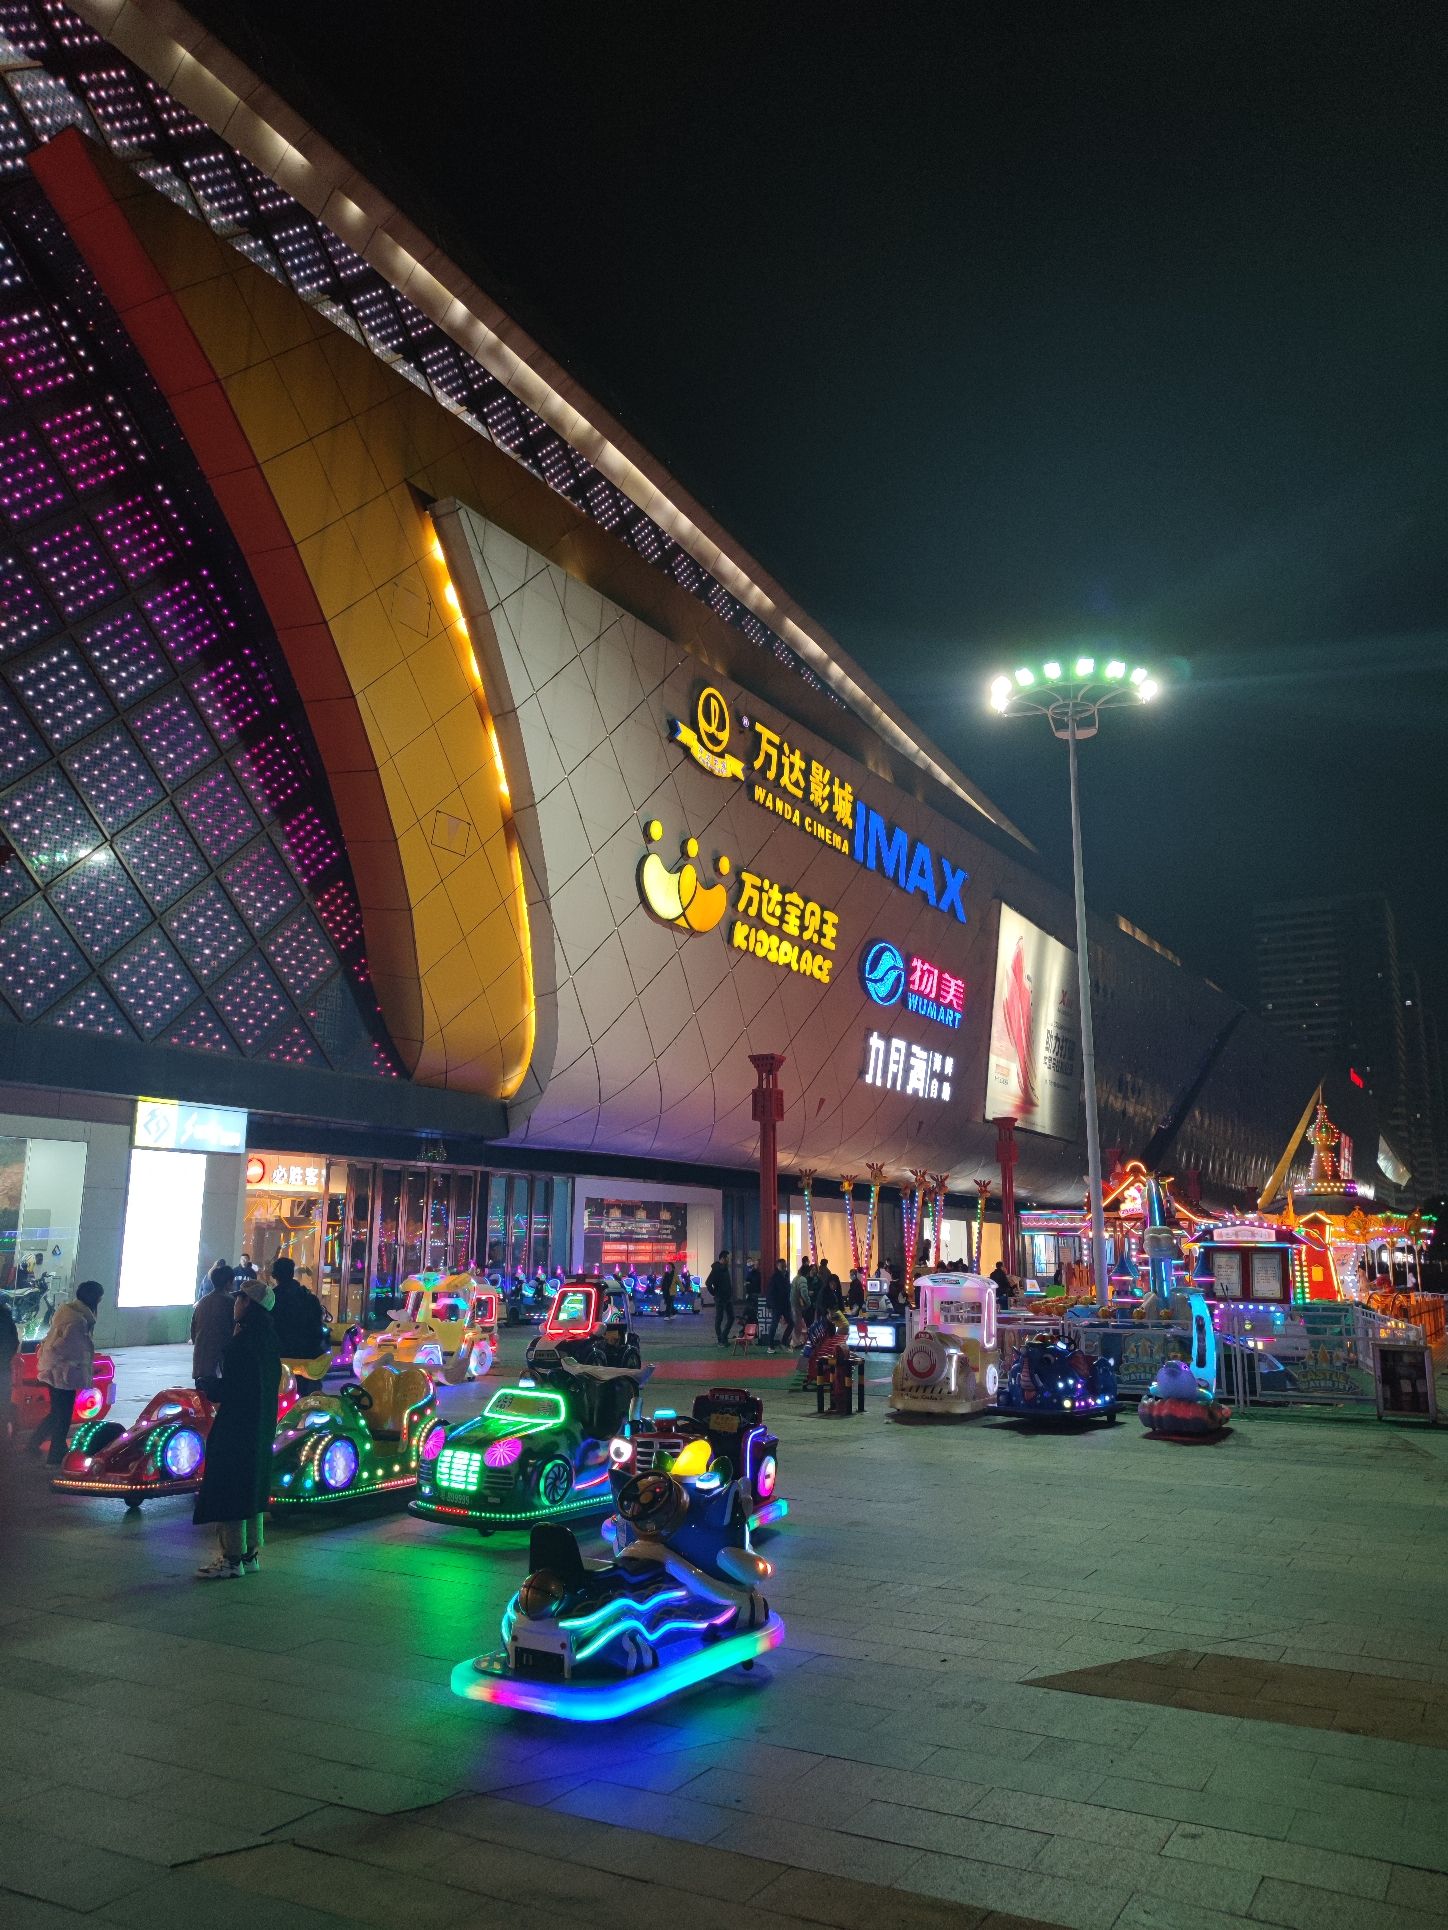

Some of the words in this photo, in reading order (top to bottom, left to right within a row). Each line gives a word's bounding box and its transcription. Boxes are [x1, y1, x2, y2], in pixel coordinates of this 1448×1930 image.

[754, 721, 855, 830] 万达影城
[755, 784, 801, 827] WANDA
[804, 816, 849, 855] CINEMA
[853, 800, 967, 924] IMAX
[737, 871, 839, 951] 万达宝贝王
[732, 920, 833, 984] KIDSPLACE
[908, 956, 966, 1013] 物美
[907, 992, 963, 1029] WUMART
[271, 1163, 327, 1185] 必胜客
